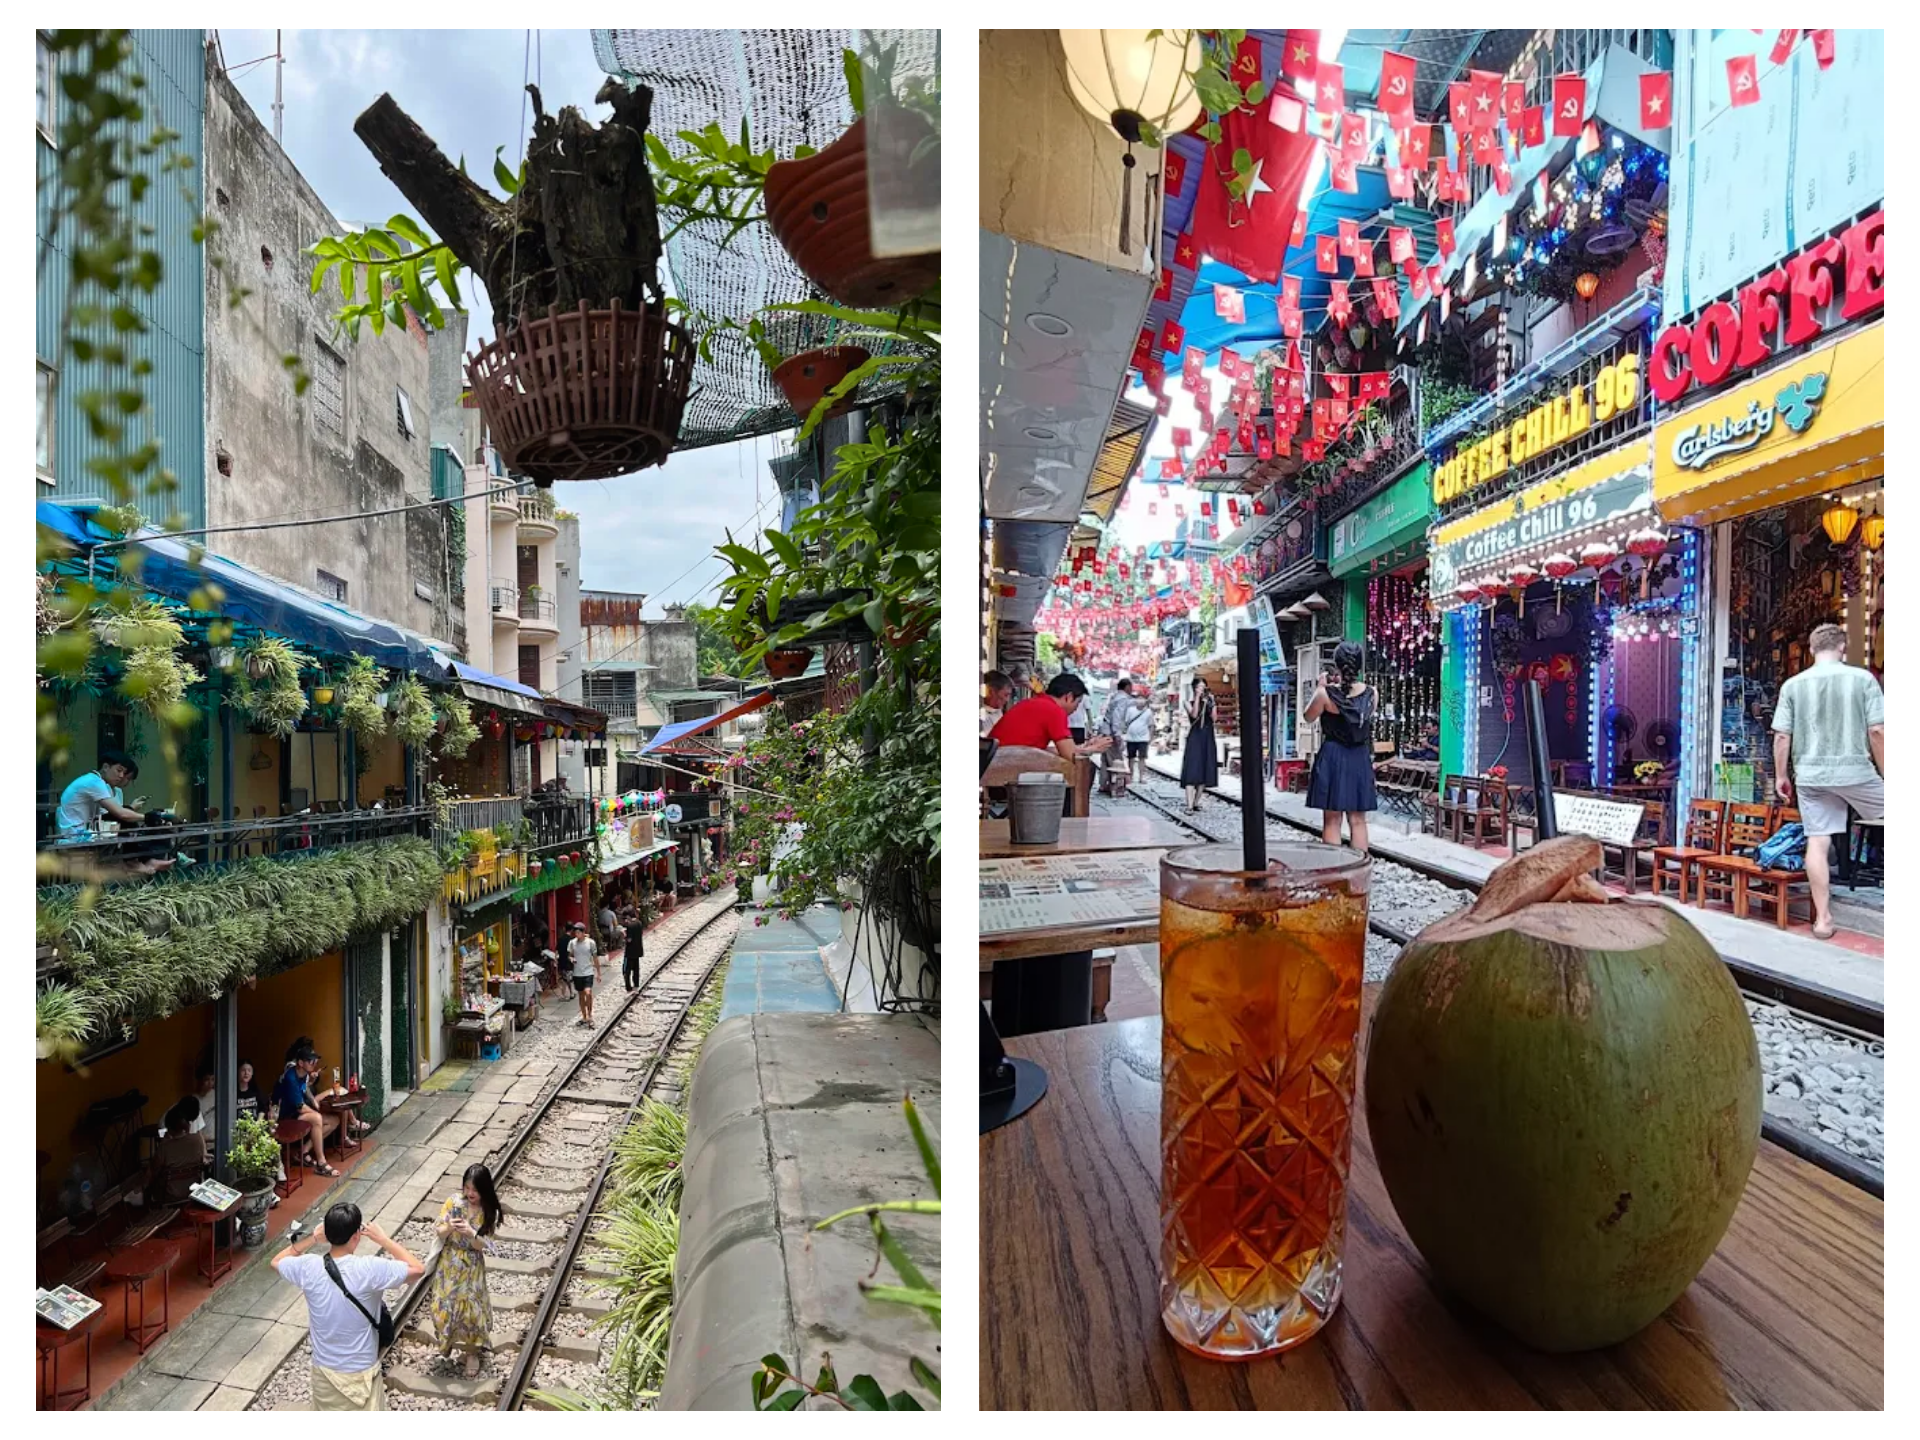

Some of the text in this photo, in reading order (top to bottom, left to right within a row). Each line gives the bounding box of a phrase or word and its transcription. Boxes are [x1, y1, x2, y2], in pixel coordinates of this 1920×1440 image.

[1433, 353, 1640, 504] COFFEE CHILL 96
[1671, 399, 1776, 469] Carlsberg
[1465, 494, 1597, 562] Coffee Chill 96
[1683, 620, 1697, 634] 96
